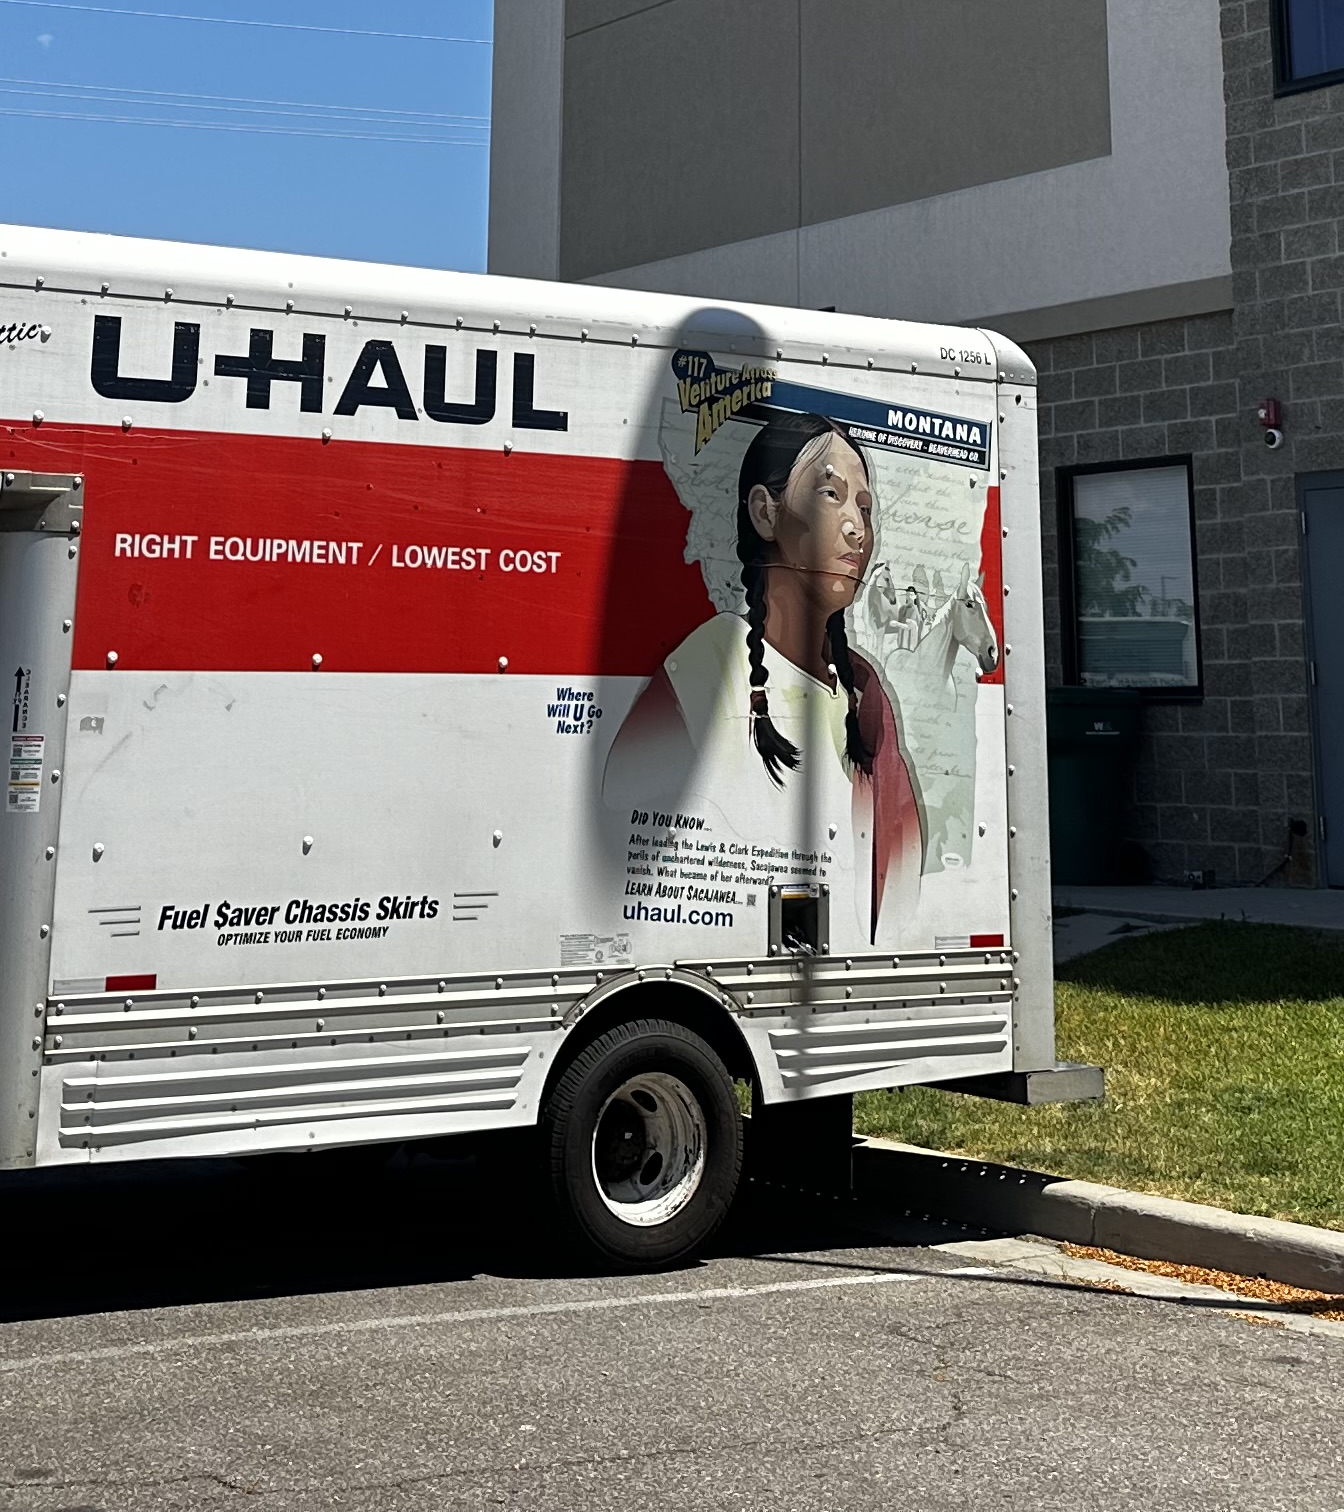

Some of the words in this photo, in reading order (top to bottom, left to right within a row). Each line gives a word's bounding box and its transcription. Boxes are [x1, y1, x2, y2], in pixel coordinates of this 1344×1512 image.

[677, 355, 708, 378] #117
[940, 347, 956, 361] DC
[958, 349, 982, 364] 1256
[984, 352, 992, 366] L
[90, 314, 569, 432] U-HAUL
[677, 369, 740, 411] Venture
[695, 381, 772, 455] America
[887, 409, 982, 445] MONTANA
[877, 433, 887, 443] OF
[114, 533, 198, 560] RIGHT
[209, 536, 363, 565] EQUIPMENT
[391, 544, 490, 570] LOWEST
[499, 549, 562, 574] COST
[556, 687, 594, 701] Where
[547, 703, 571, 718] Will
[573, 703, 585, 722] U
[587, 704, 603, 719] Go
[556, 719, 594, 734] Next?
[631, 809, 649, 825] DID
[652, 810, 673, 827] YOU
[628, 834, 649, 846] After
[681, 838, 693, 850] the
[695, 840, 717, 853] Lewis
[718, 842, 726, 854] &
[729, 843, 749, 856] Clark
[651, 850, 661, 863] of
[819, 867, 827, 877] to
[657, 866, 677, 878] What
[709, 869, 719, 881] of
[720, 871, 733, 883] her
[624, 879, 654, 896] LEARN
[654, 882, 685, 899] ABOUT
[157, 903, 210, 931] Fuel
[284, 897, 370, 924] Chassis
[375, 895, 440, 921] Skirts
[623, 901, 733, 927] uhaul.com
[217, 932, 271, 947] OPTIMIZE
[273, 930, 303, 944] YOUR
[305, 928, 332, 942] FUEL
[335, 926, 390, 941] ECONOMY
